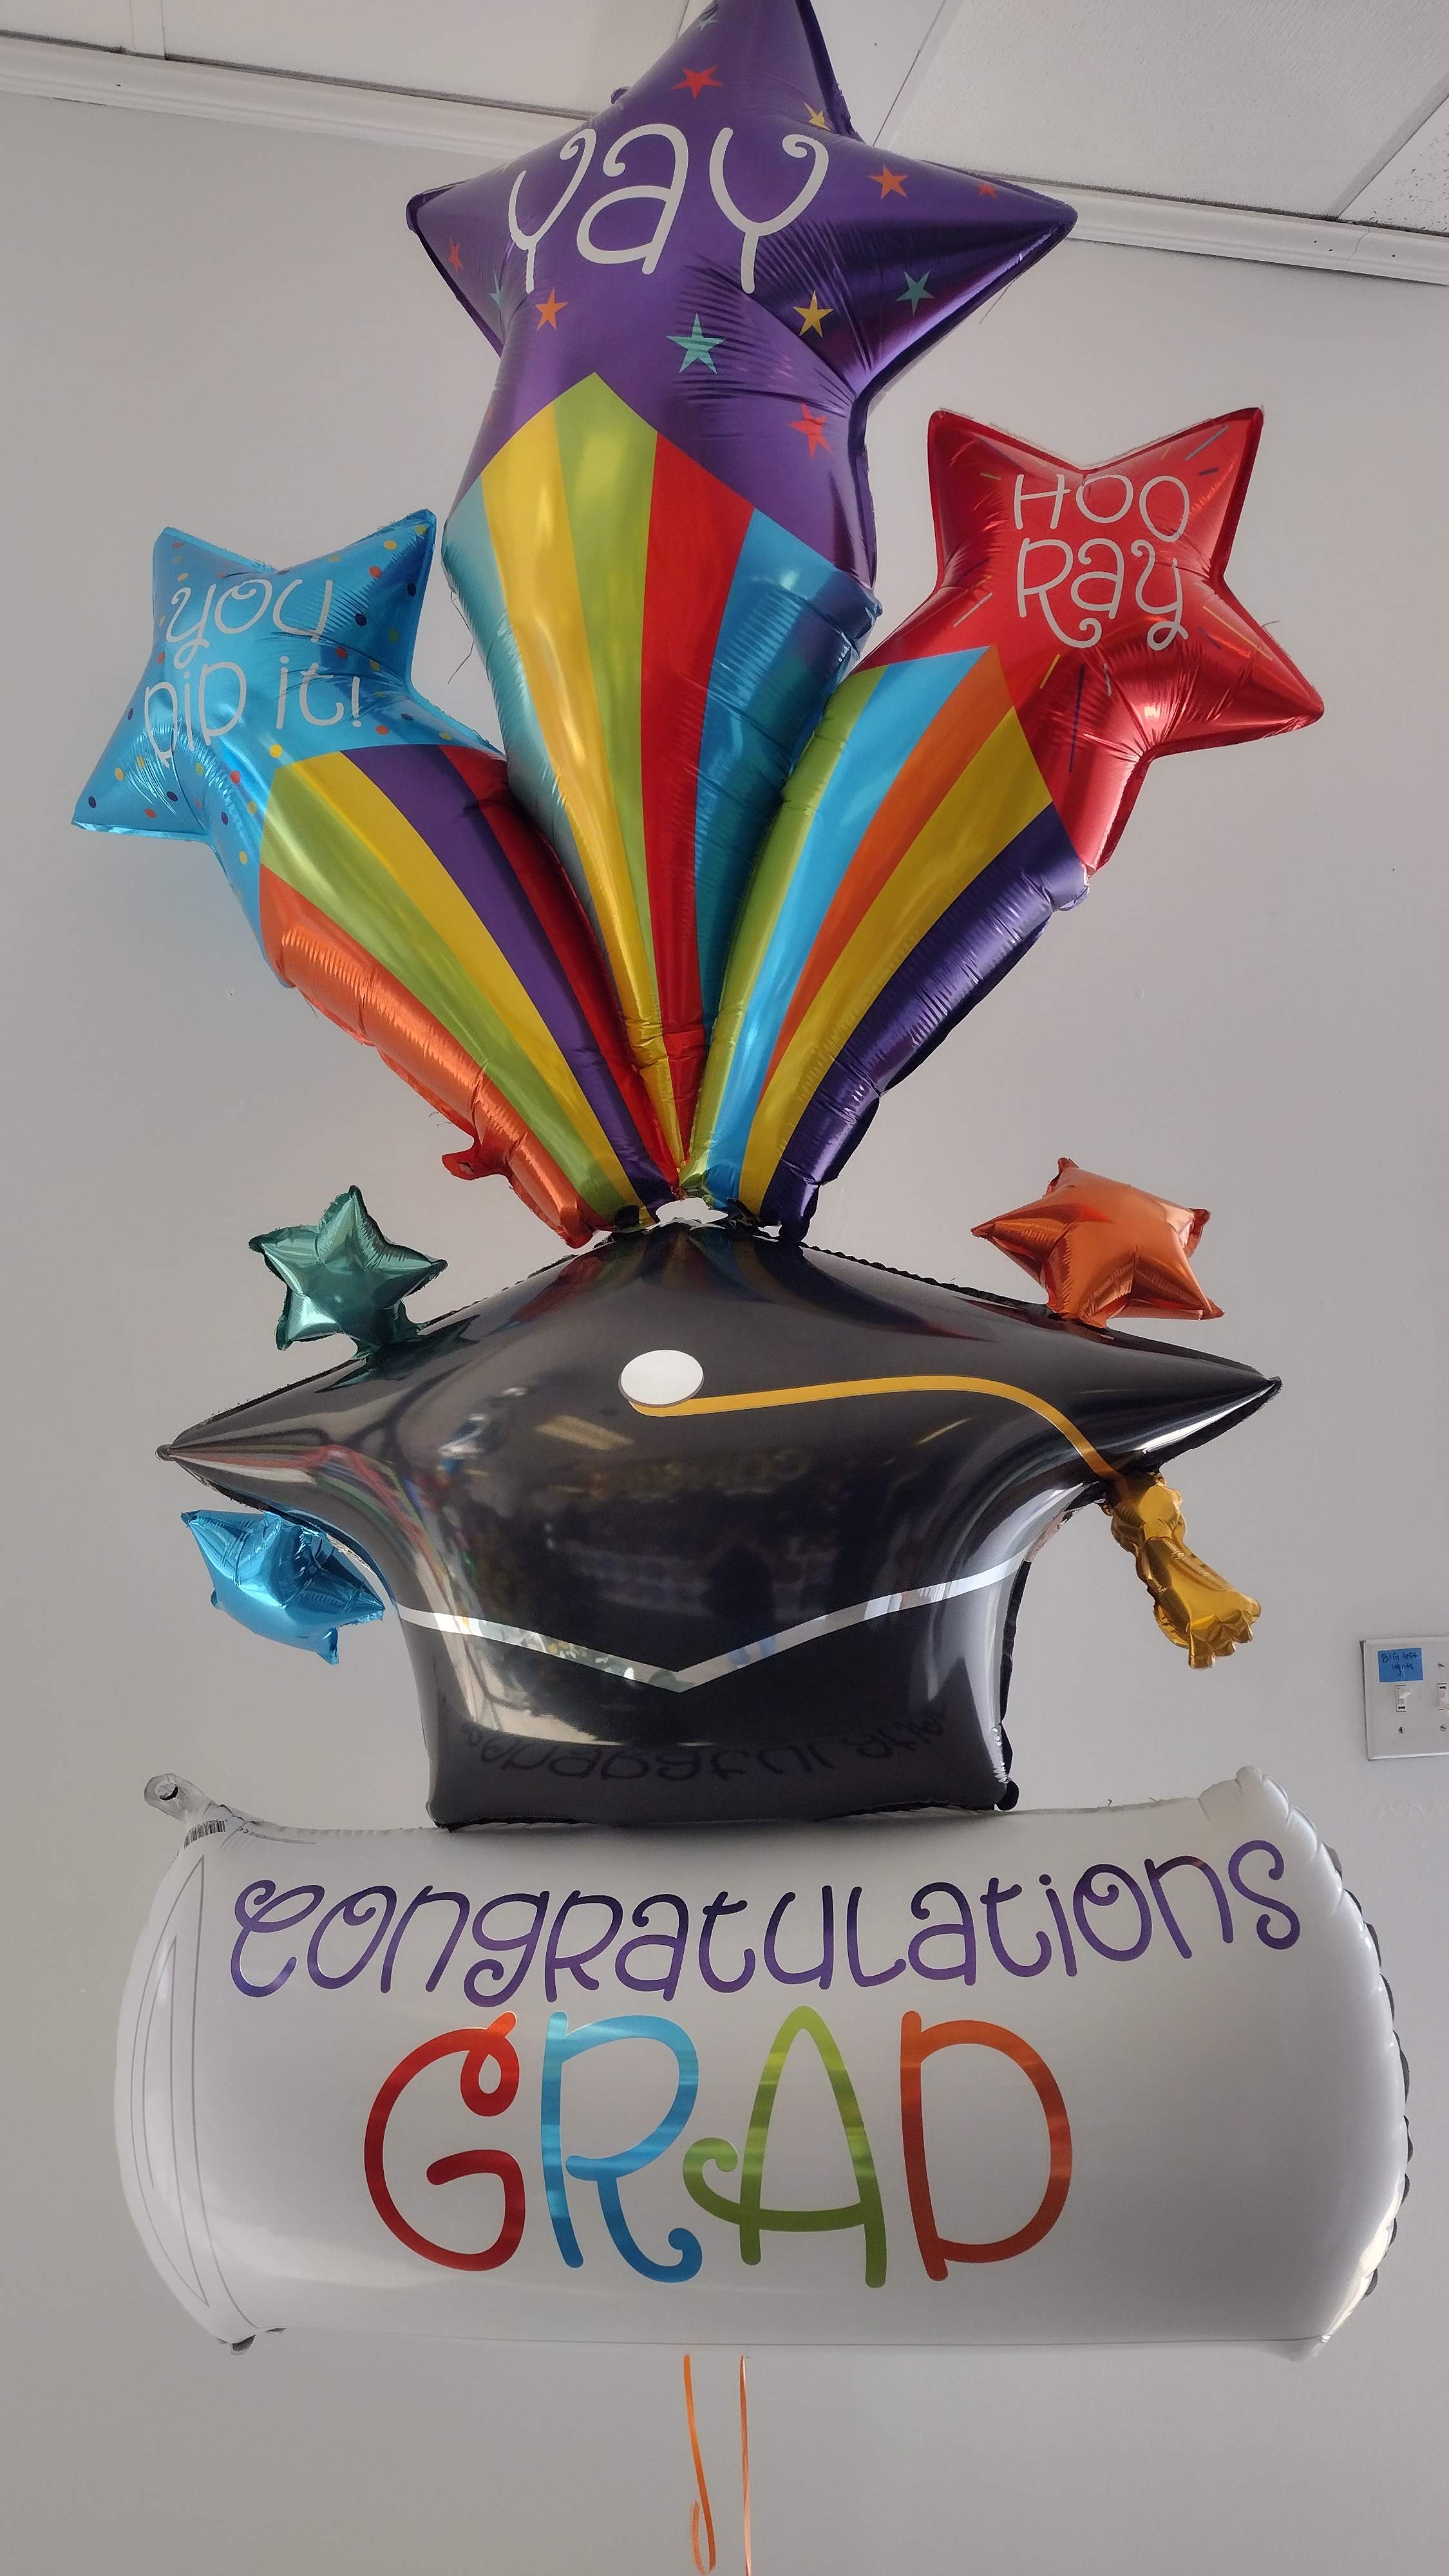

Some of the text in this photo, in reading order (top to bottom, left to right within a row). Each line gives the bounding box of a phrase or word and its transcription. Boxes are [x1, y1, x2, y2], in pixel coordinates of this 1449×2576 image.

[1014, 474, 1190, 542] HOO
[1381, 1651, 1418, 1663] BIG left
[364, 2005, 1072, 2289] GRAD
